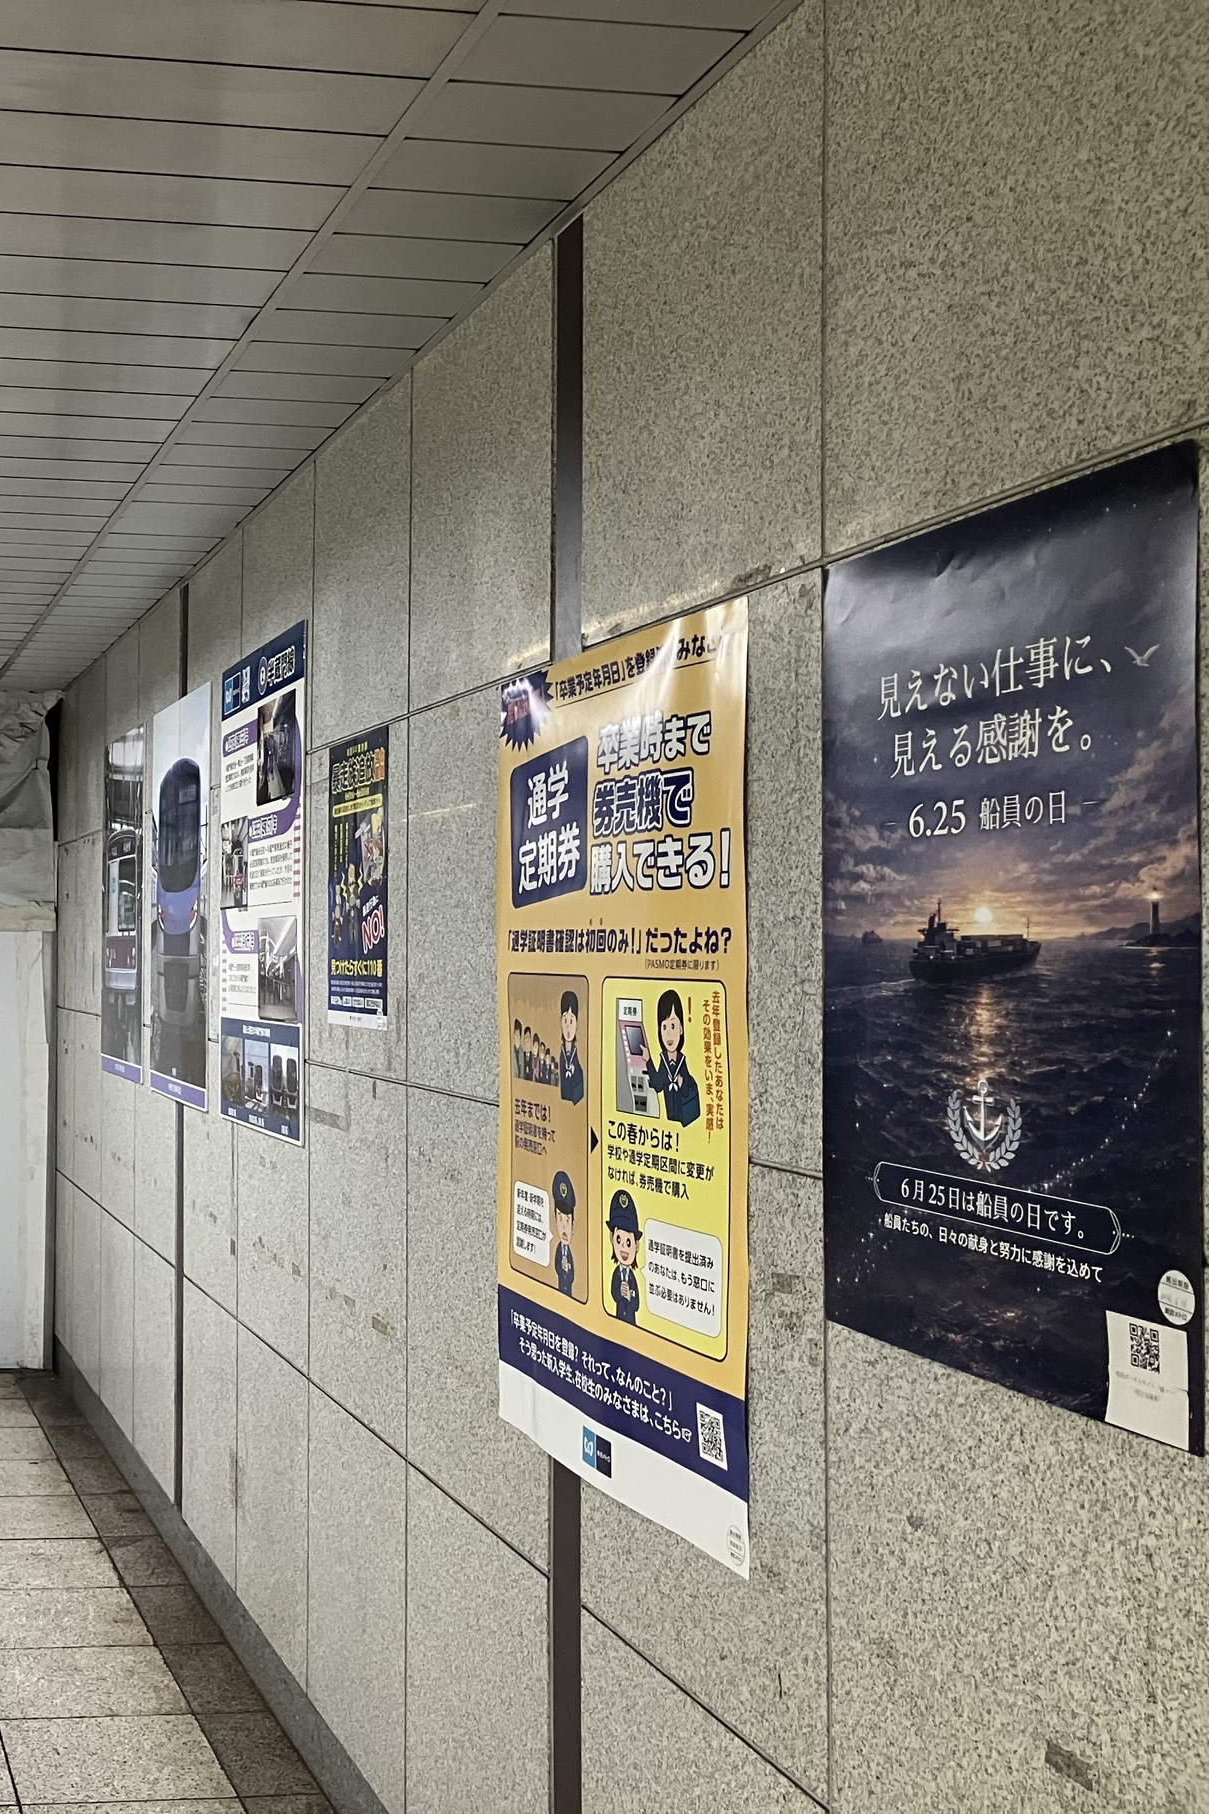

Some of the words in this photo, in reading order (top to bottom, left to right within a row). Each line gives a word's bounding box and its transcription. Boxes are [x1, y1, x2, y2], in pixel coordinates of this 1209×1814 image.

[878, 635, 1112, 721] 見えない仕事に、
[597, 711, 712, 773] 卒業時まで
[890, 705, 1091, 779] 見える感謝を。
[527, 760, 569, 829] 通学
[593, 767, 693, 838] 券売機で
[908, 799, 967, 838] 6.25
[979, 790, 1066, 831] 船員の日
[518, 821, 581, 894] 定期券
[590, 828, 732, 896] 購入できる！
[362, 904, 385, 954] NO!
[712, 990, 724, 1130] 去年登録したあなたは
[607, 1144, 715, 1181] 学校や通学定期区間に変更が
[608, 1120, 679, 1152] この春からは！
[607, 1165, 690, 1200] なければ、券売機で購入
[900, 1177, 1086, 1240] 6月25日は船員の日です。
[648, 1239, 714, 1270] 通学証明書を提出済み
